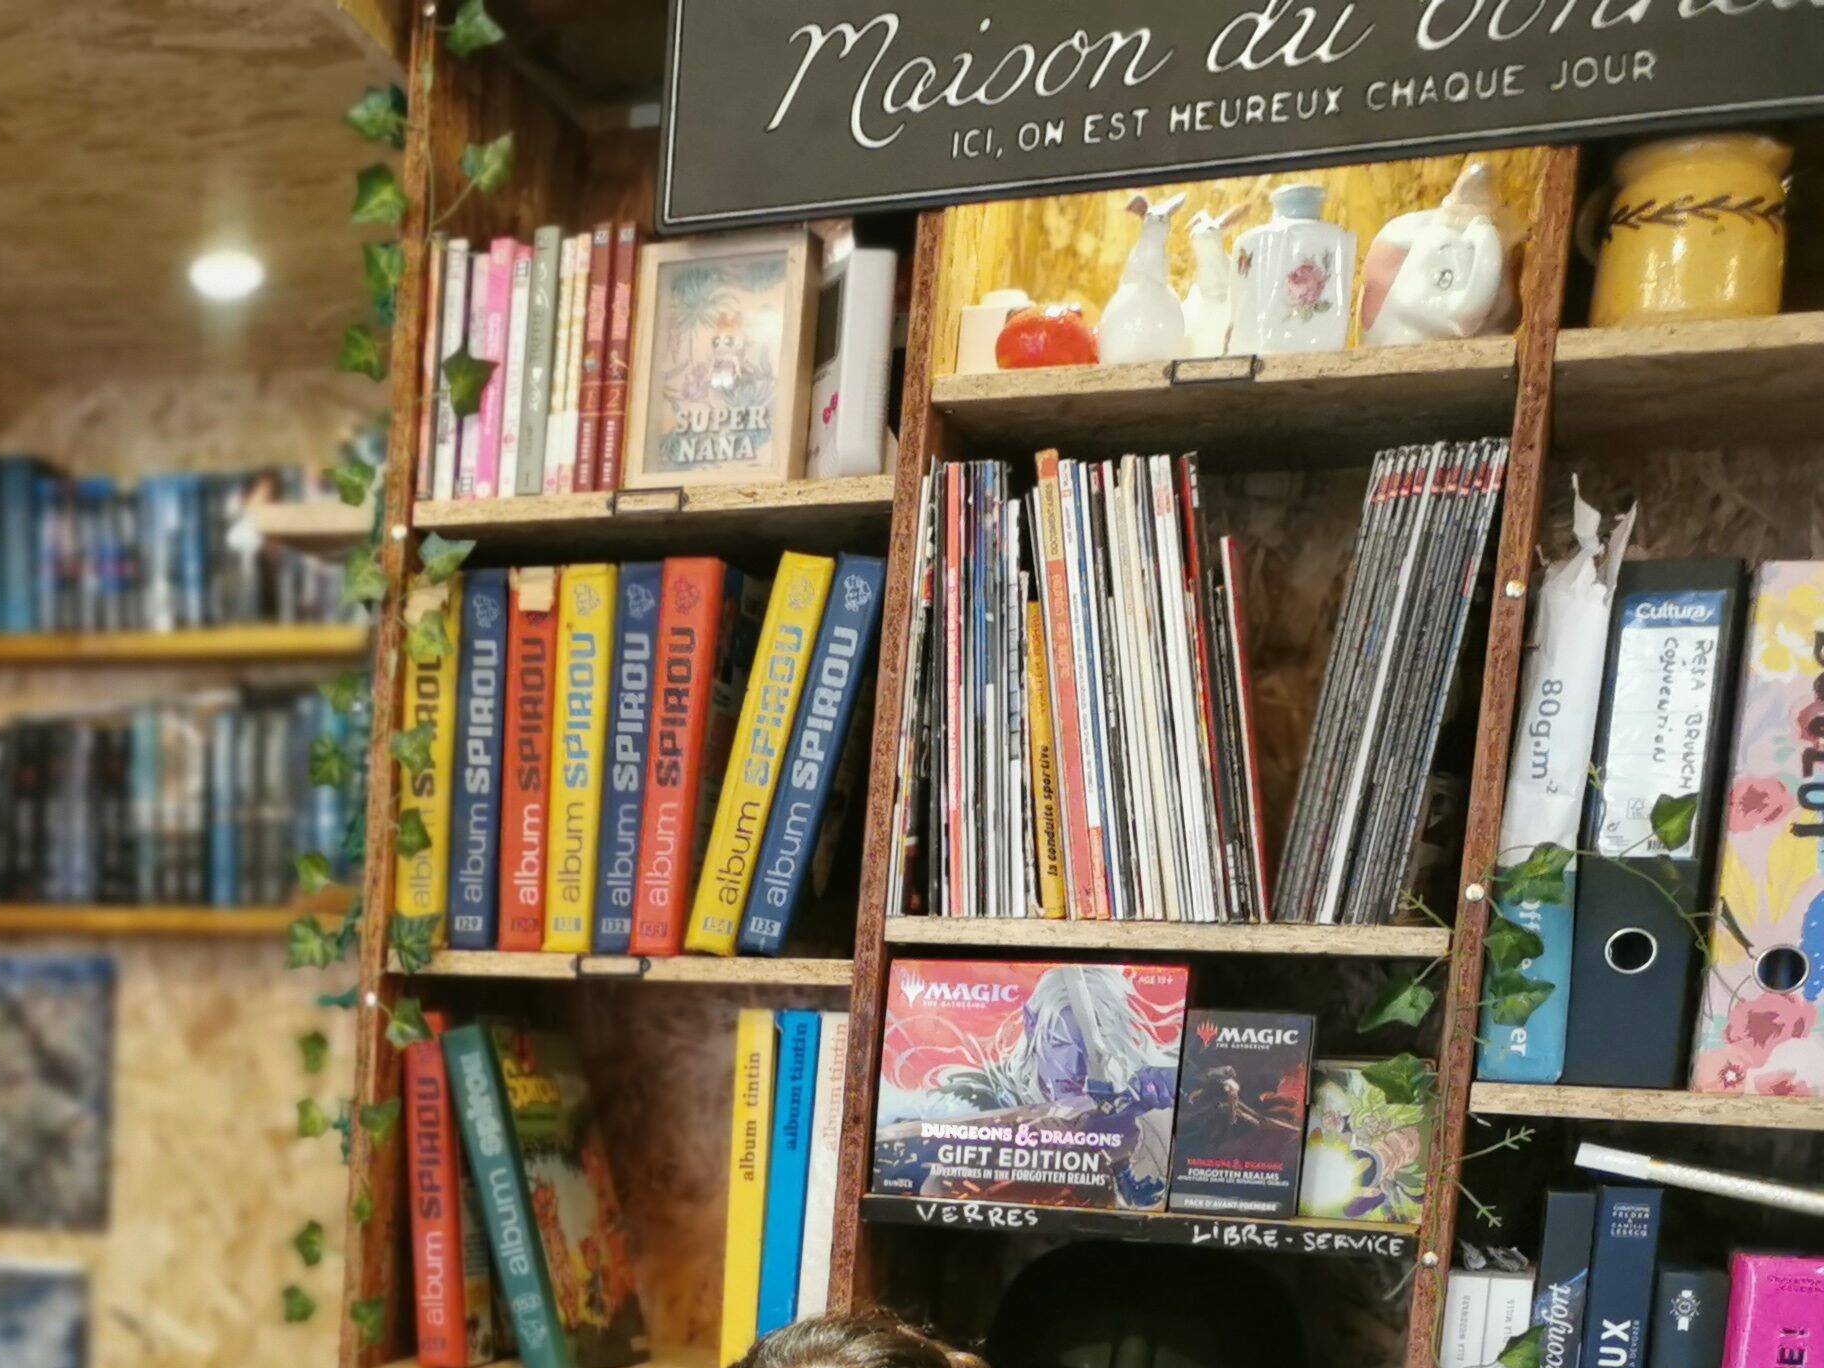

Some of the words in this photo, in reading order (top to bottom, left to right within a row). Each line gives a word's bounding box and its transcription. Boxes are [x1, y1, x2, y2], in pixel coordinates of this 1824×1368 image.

[766, 13, 1174, 148] Maison
[1207, 0, 1373, 72] du
[951, 129, 1004, 159] ICI,
[1018, 121, 1064, 152] ON
[1083, 109, 1148, 144] EST
[1170, 85, 1343, 133] HEUREUX
[1366, 64, 1526, 111] CHAQUE
[1550, 50, 1658, 91] JOUR
[676, 404, 768, 433] SUPER
[678, 430, 757, 463] NANA
[1635, 600, 1715, 622] Cultura
[465, 640, 497, 794] SPIROU
[517, 637, 546, 793] SPIROU
[564, 631, 597, 789] SPIROU
[612, 632, 651, 793] SPIROU
[656, 626, 697, 789] SPIROU
[717, 801, 760, 906] album
[744, 624, 804, 788] SPIROU
[764, 802, 811, 908] album
[791, 625, 859, 791] SPIROU
[1039, 745, 1054, 800] sportive
[460, 803, 488, 904] album
[513, 803, 540, 906] album
[557, 801, 584, 903] album
[606, 803, 638, 907] album
[644, 802, 680, 907] album
[1042, 804, 1058, 862] conduite
[925, 982, 1019, 1003] MAGIC
[789, 1022, 808, 1081] tintin
[829, 1023, 848, 1081] tintin
[1217, 1027, 1299, 1045] MAGIC
[743, 1052, 761, 1107] tintin
[417, 1077, 441, 1220] SPIROU
[740, 1120, 757, 1182] album
[783, 1085, 803, 1151] album
[823, 1088, 843, 1152] album
[921, 1122, 1012, 1140] DUNGEONS
[1014, 1123, 1039, 1147] &
[1040, 1130, 1123, 1147] DRAGONS
[930, 1164, 982, 1178] ADVENTURES
[983, 1169, 992, 1178] IN
[994, 1169, 1009, 1180] THE
[1011, 1169, 1066, 1183] FORGOTTEN
[1067, 1172, 1106, 1186] REALMS
[938, 1145, 992, 1166] GIFT
[998, 1148, 1100, 1172] EDITION
[1188, 1168, 1242, 1178] FORGOTTEN
[488, 1167, 530, 1275] album
[916, 1203, 1039, 1227] VERRES
[423, 1230, 445, 1326] album
